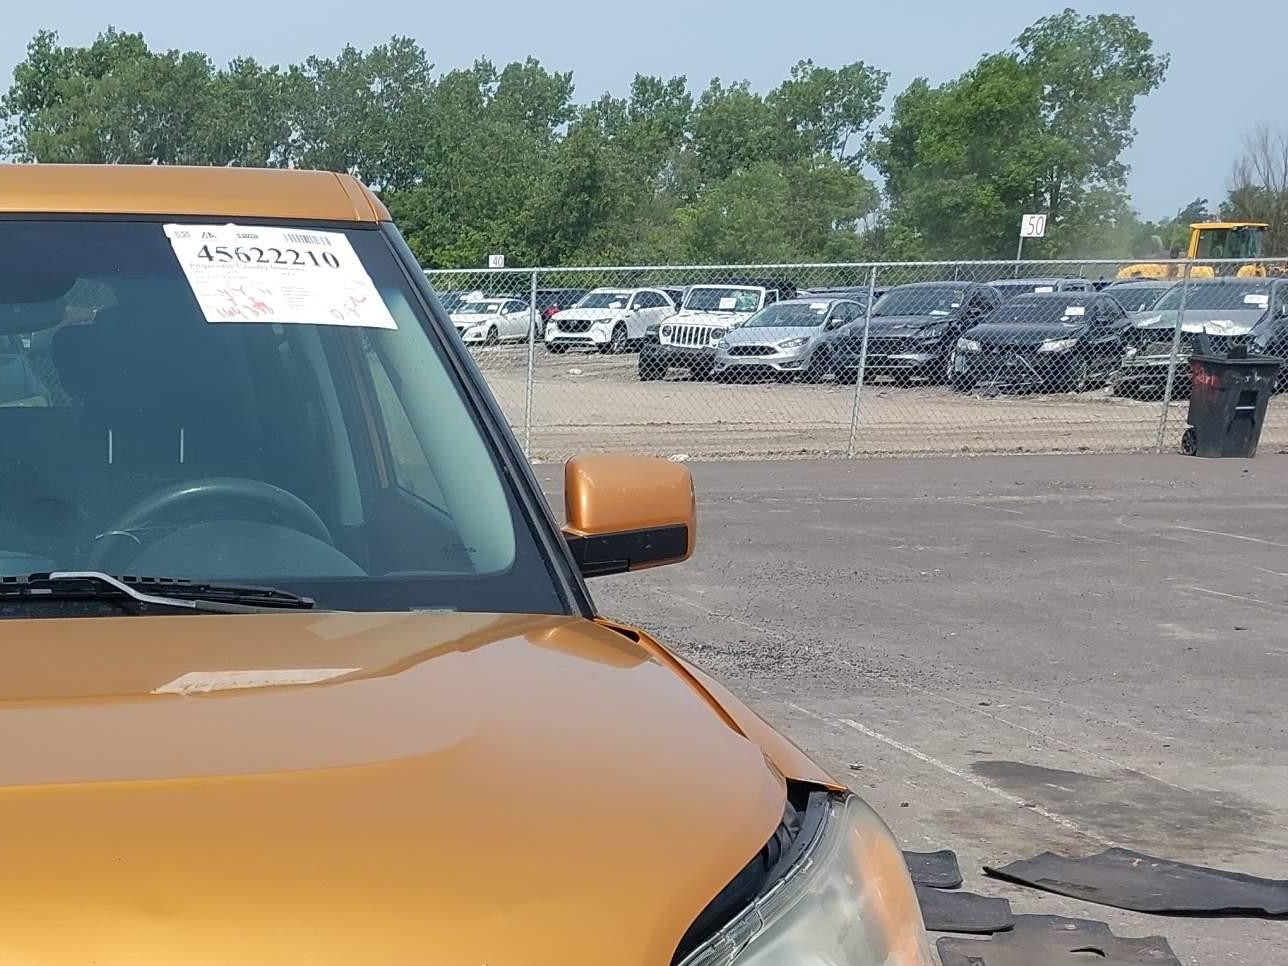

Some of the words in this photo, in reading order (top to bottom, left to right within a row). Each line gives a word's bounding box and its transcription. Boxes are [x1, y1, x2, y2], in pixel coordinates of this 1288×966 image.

[1026, 215, 1044, 235] 50
[197, 244, 340, 270] 45622210
[492, 255, 504, 267] 40
